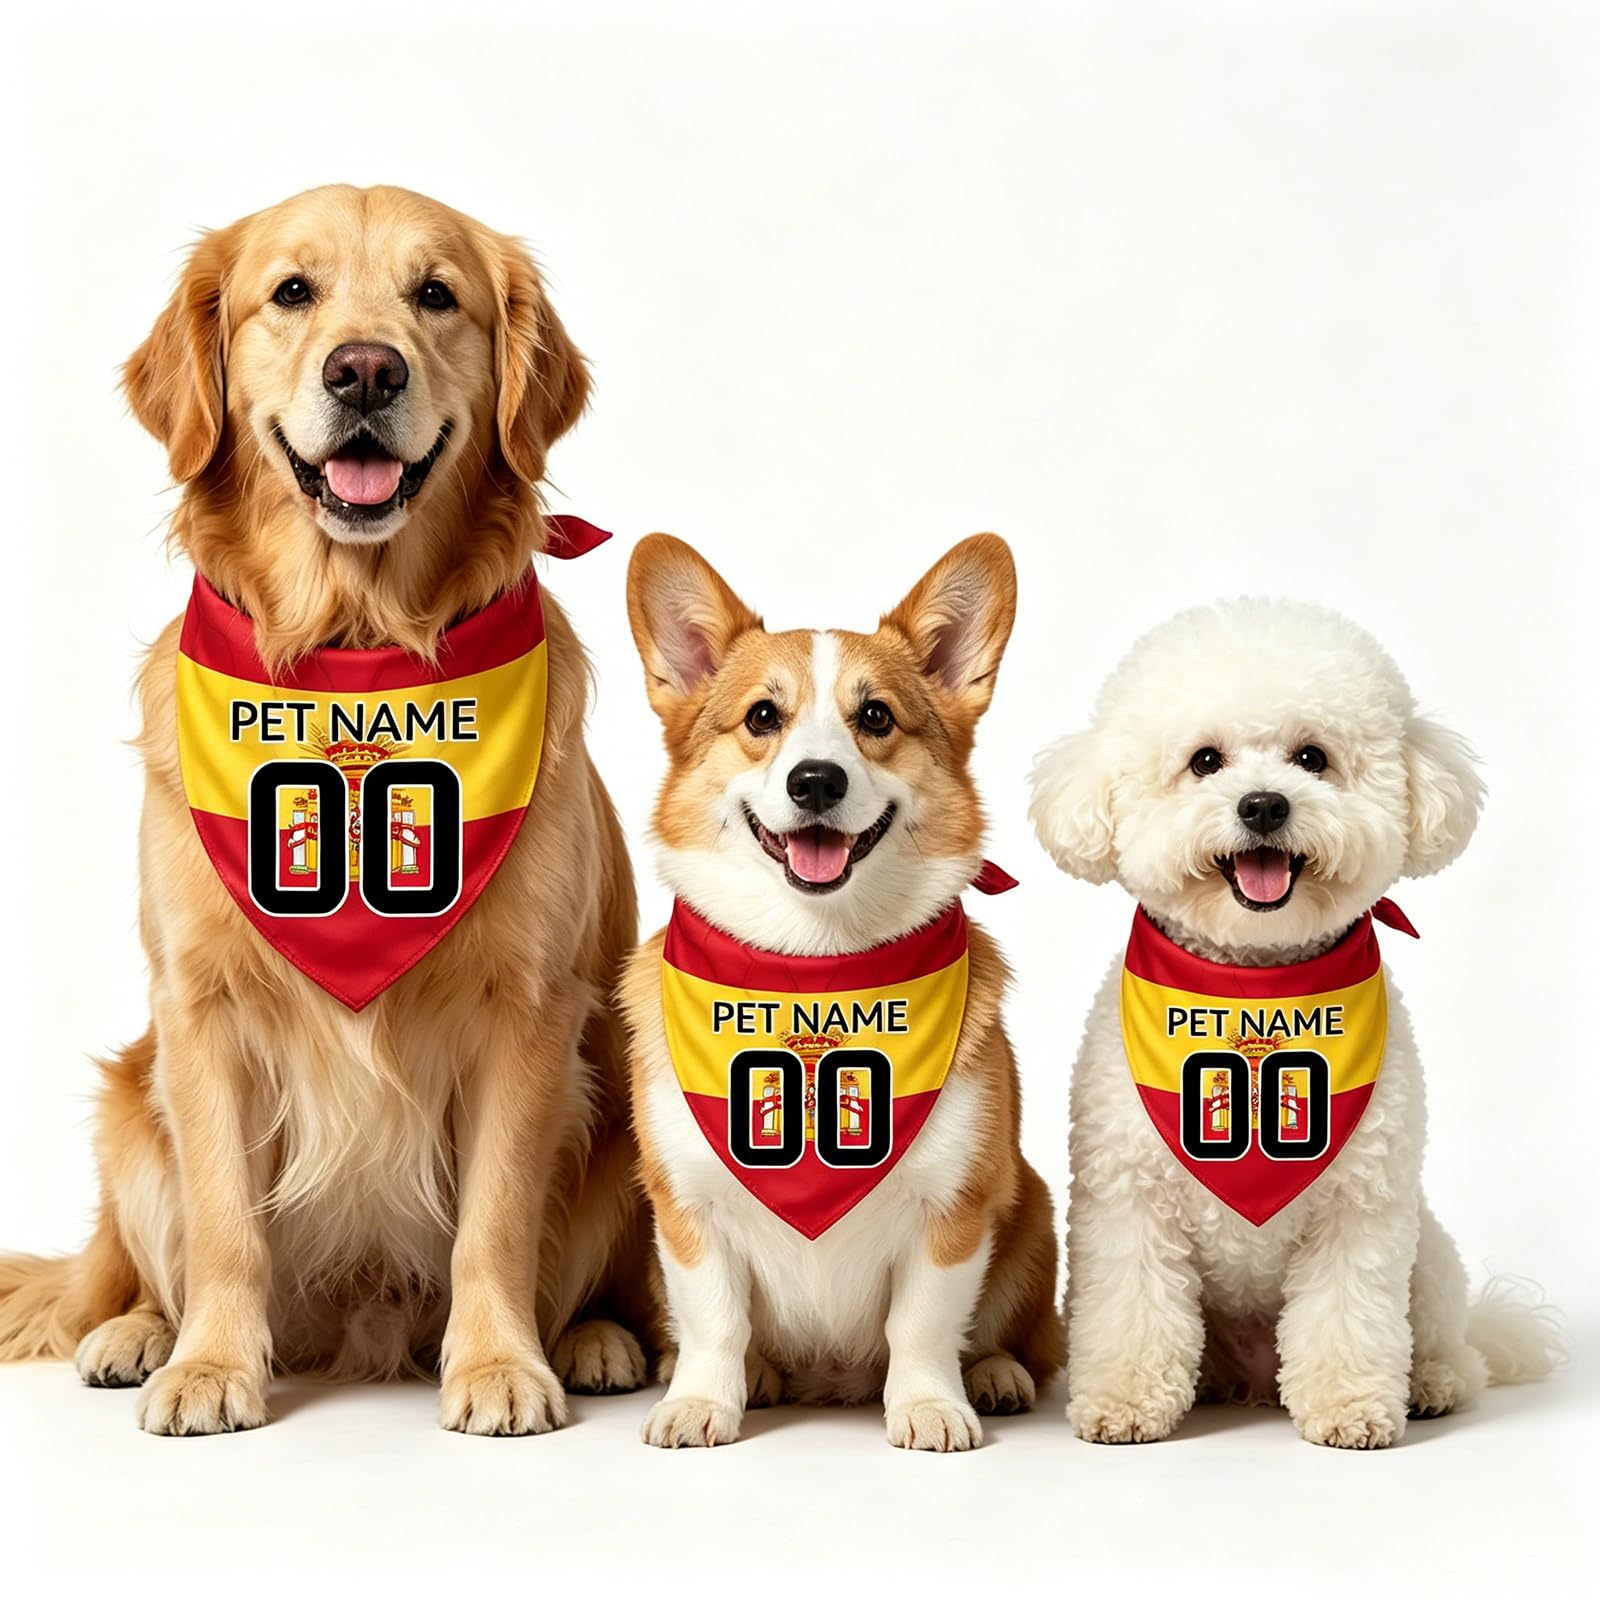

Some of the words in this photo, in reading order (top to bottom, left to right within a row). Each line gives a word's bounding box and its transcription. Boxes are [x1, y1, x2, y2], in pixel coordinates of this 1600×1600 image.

[231, 700, 315, 742] PET
[330, 699, 478, 742] NAME
[249, 760, 462, 916] 00
[713, 1000, 780, 1034] PET
[793, 999, 909, 1035] NAME
[1167, 1006, 1230, 1038] PET
[1240, 1006, 1344, 1038] NAME
[729, 1049, 893, 1168] 00
[1181, 1051, 1330, 1161] 00
